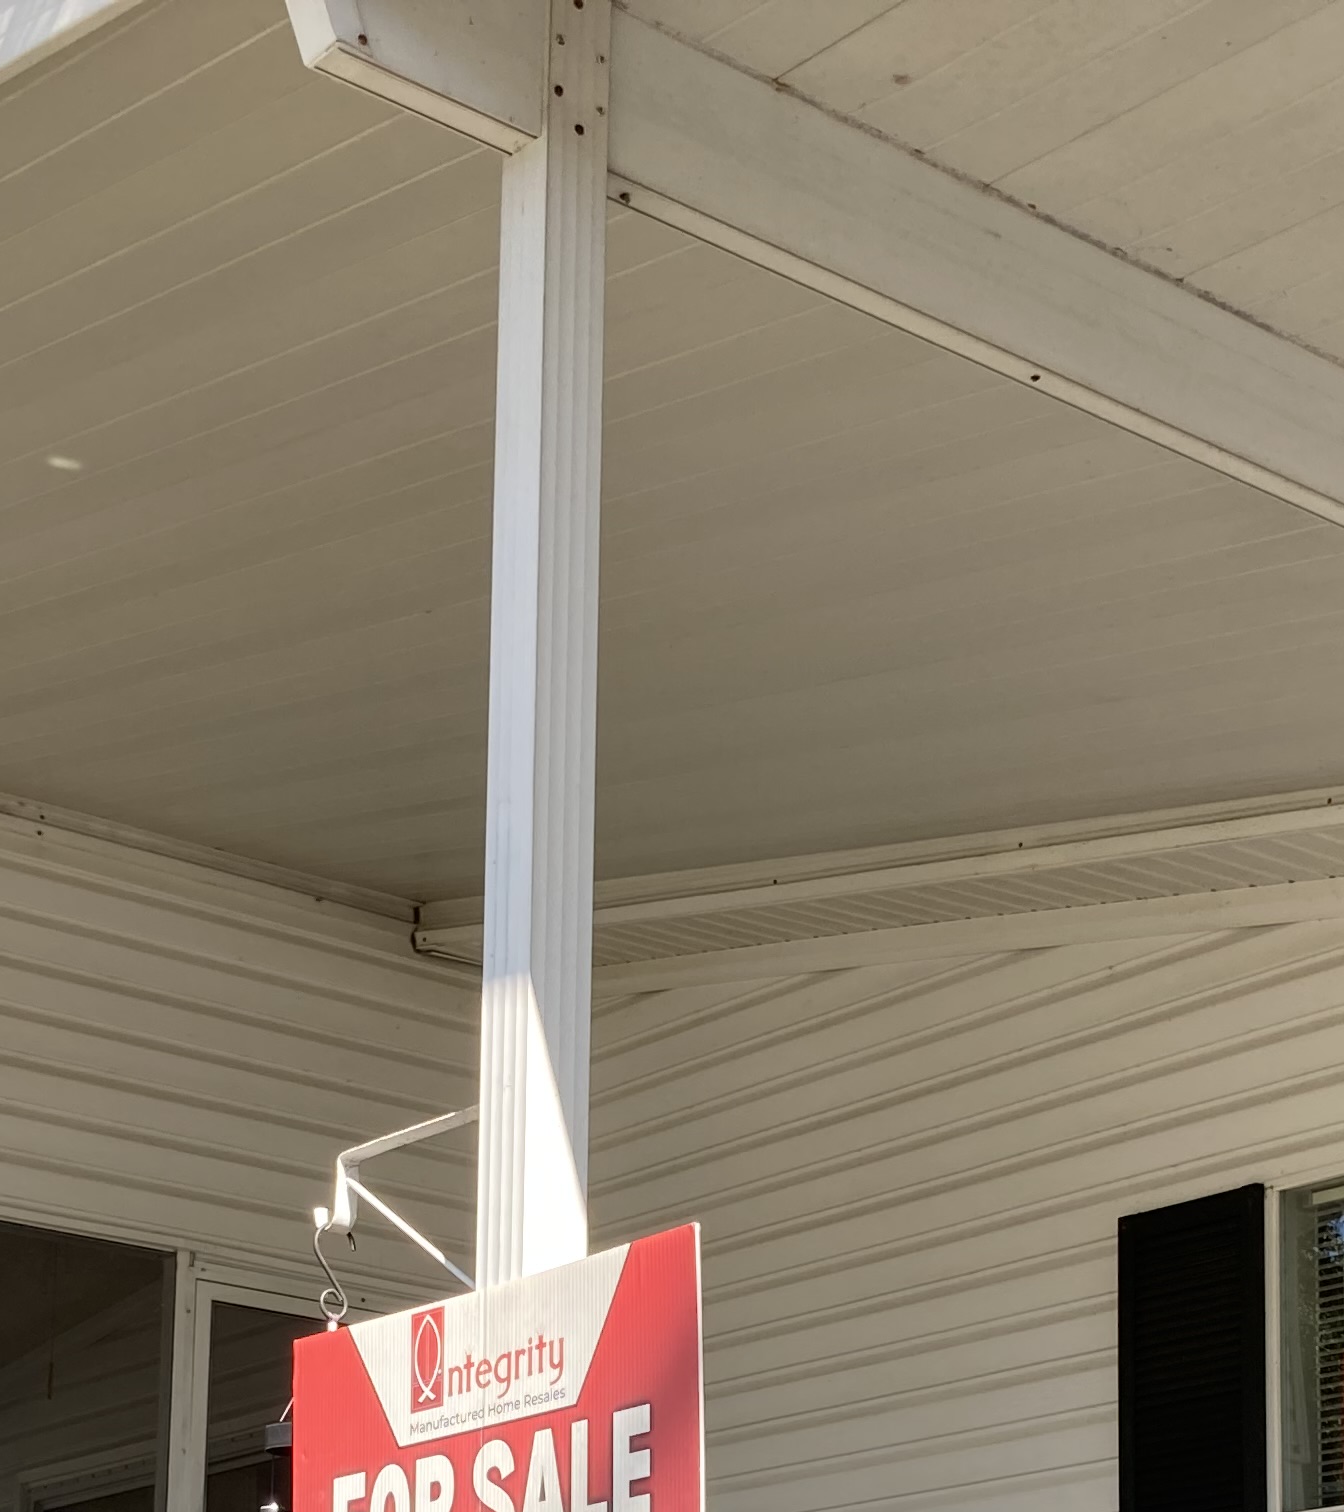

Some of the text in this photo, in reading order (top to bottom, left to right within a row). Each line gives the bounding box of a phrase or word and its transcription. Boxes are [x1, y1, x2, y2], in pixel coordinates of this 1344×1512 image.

[409, 1386, 566, 1437] Manufactured Home Resales
